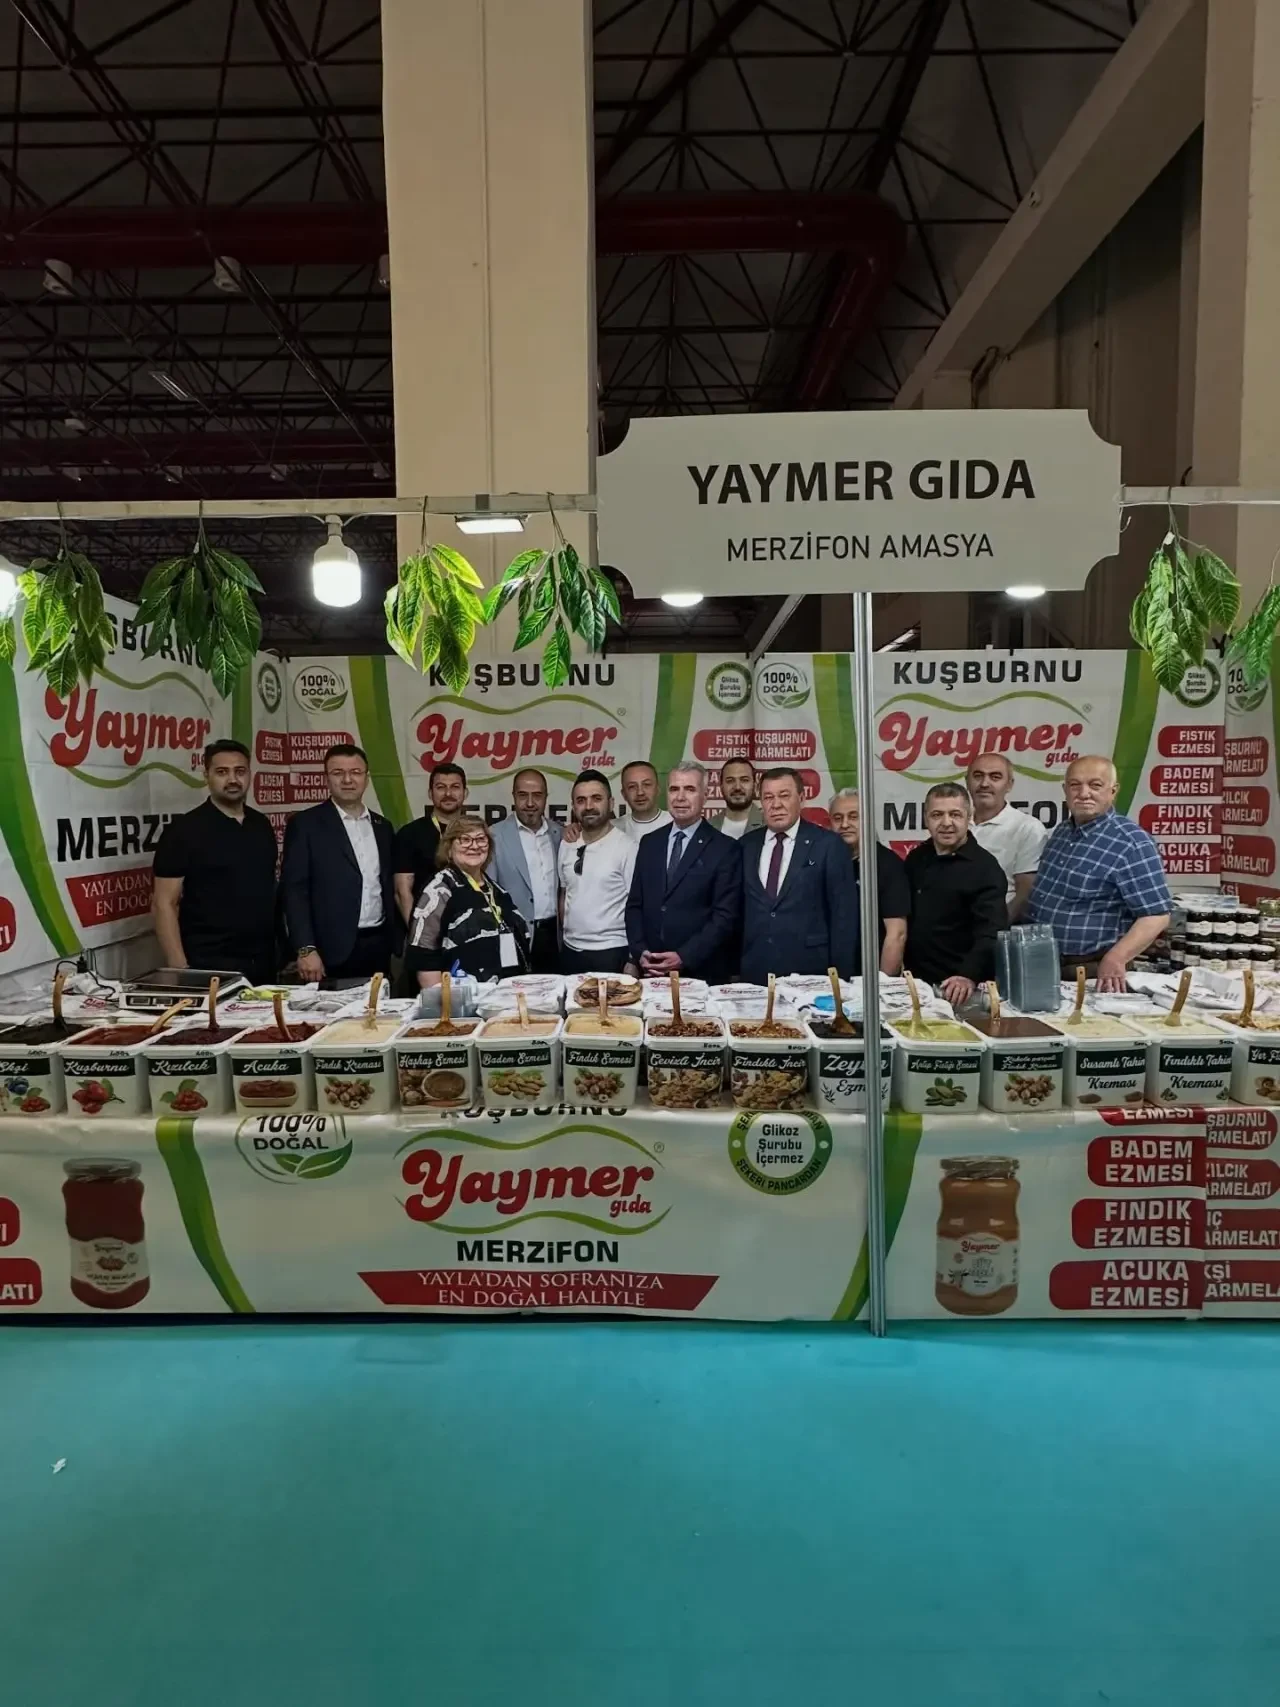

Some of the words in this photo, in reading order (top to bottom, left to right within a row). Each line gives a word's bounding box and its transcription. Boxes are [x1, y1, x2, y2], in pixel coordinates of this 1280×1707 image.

[687, 461, 894, 505] YAYMER
[908, 460, 1036, 500] GIDA
[727, 530, 870, 562] MERZİFON
[880, 533, 994, 559] AMASYA
[300, 674, 336, 687] 100%
[763, 671, 798, 684] 100%
[894, 660, 1083, 690] KUŞBURNU
[763, 684, 800, 694] DOĞAL
[44, 684, 211, 767] Yaymer
[416, 713, 618, 772] Yaymer
[716, 734, 750, 745] FISTIK
[878, 711, 1083, 772] Yaymer
[1179, 731, 1216, 742] FISTIK
[1171, 742, 1216, 755] EZMESİ
[1163, 767, 1215, 780] BADEM
[1160, 780, 1214, 794] EZMESİ
[1158, 805, 1213, 818] FINDIK
[1152, 819, 1213, 835] EZMESİ
[1159, 843, 1211, 857] ACUKA
[1163, 857, 1210, 873] ZMESİ
[96, 899, 114, 916] EN
[64, 1060, 130, 1075] Kuşburnu
[243, 1059, 290, 1074] Acuka
[1087, 1077, 1137, 1090] Kreması
[1170, 1075, 1224, 1089] Kreması
[256, 1114, 327, 1133] 100%
[762, 1124, 799, 1136] Glikoz
[253, 1133, 329, 1150] DOĞAL
[758, 1138, 802, 1152] Şurubu
[1110, 1140, 1193, 1159] BADEM
[756, 1149, 804, 1167] İçermez
[1105, 1159, 1192, 1183] EZMESİ
[402, 1149, 655, 1222] Yaymer
[609, 1194, 653, 1218] gıda
[1105, 1200, 1192, 1221] FINDIK
[1094, 1221, 1190, 1248] EZMESİ
[1102, 1261, 1190, 1281] ACUKA
[418, 1271, 533, 1288] YAYLA'DAN
[540, 1271, 664, 1290] SOFRANIZA
[439, 1289, 465, 1304] EN
[474, 1288, 551, 1306] DOĞAL
[559, 1288, 646, 1306] HALİYLE
[1090, 1282, 1188, 1307] EZMESİ
